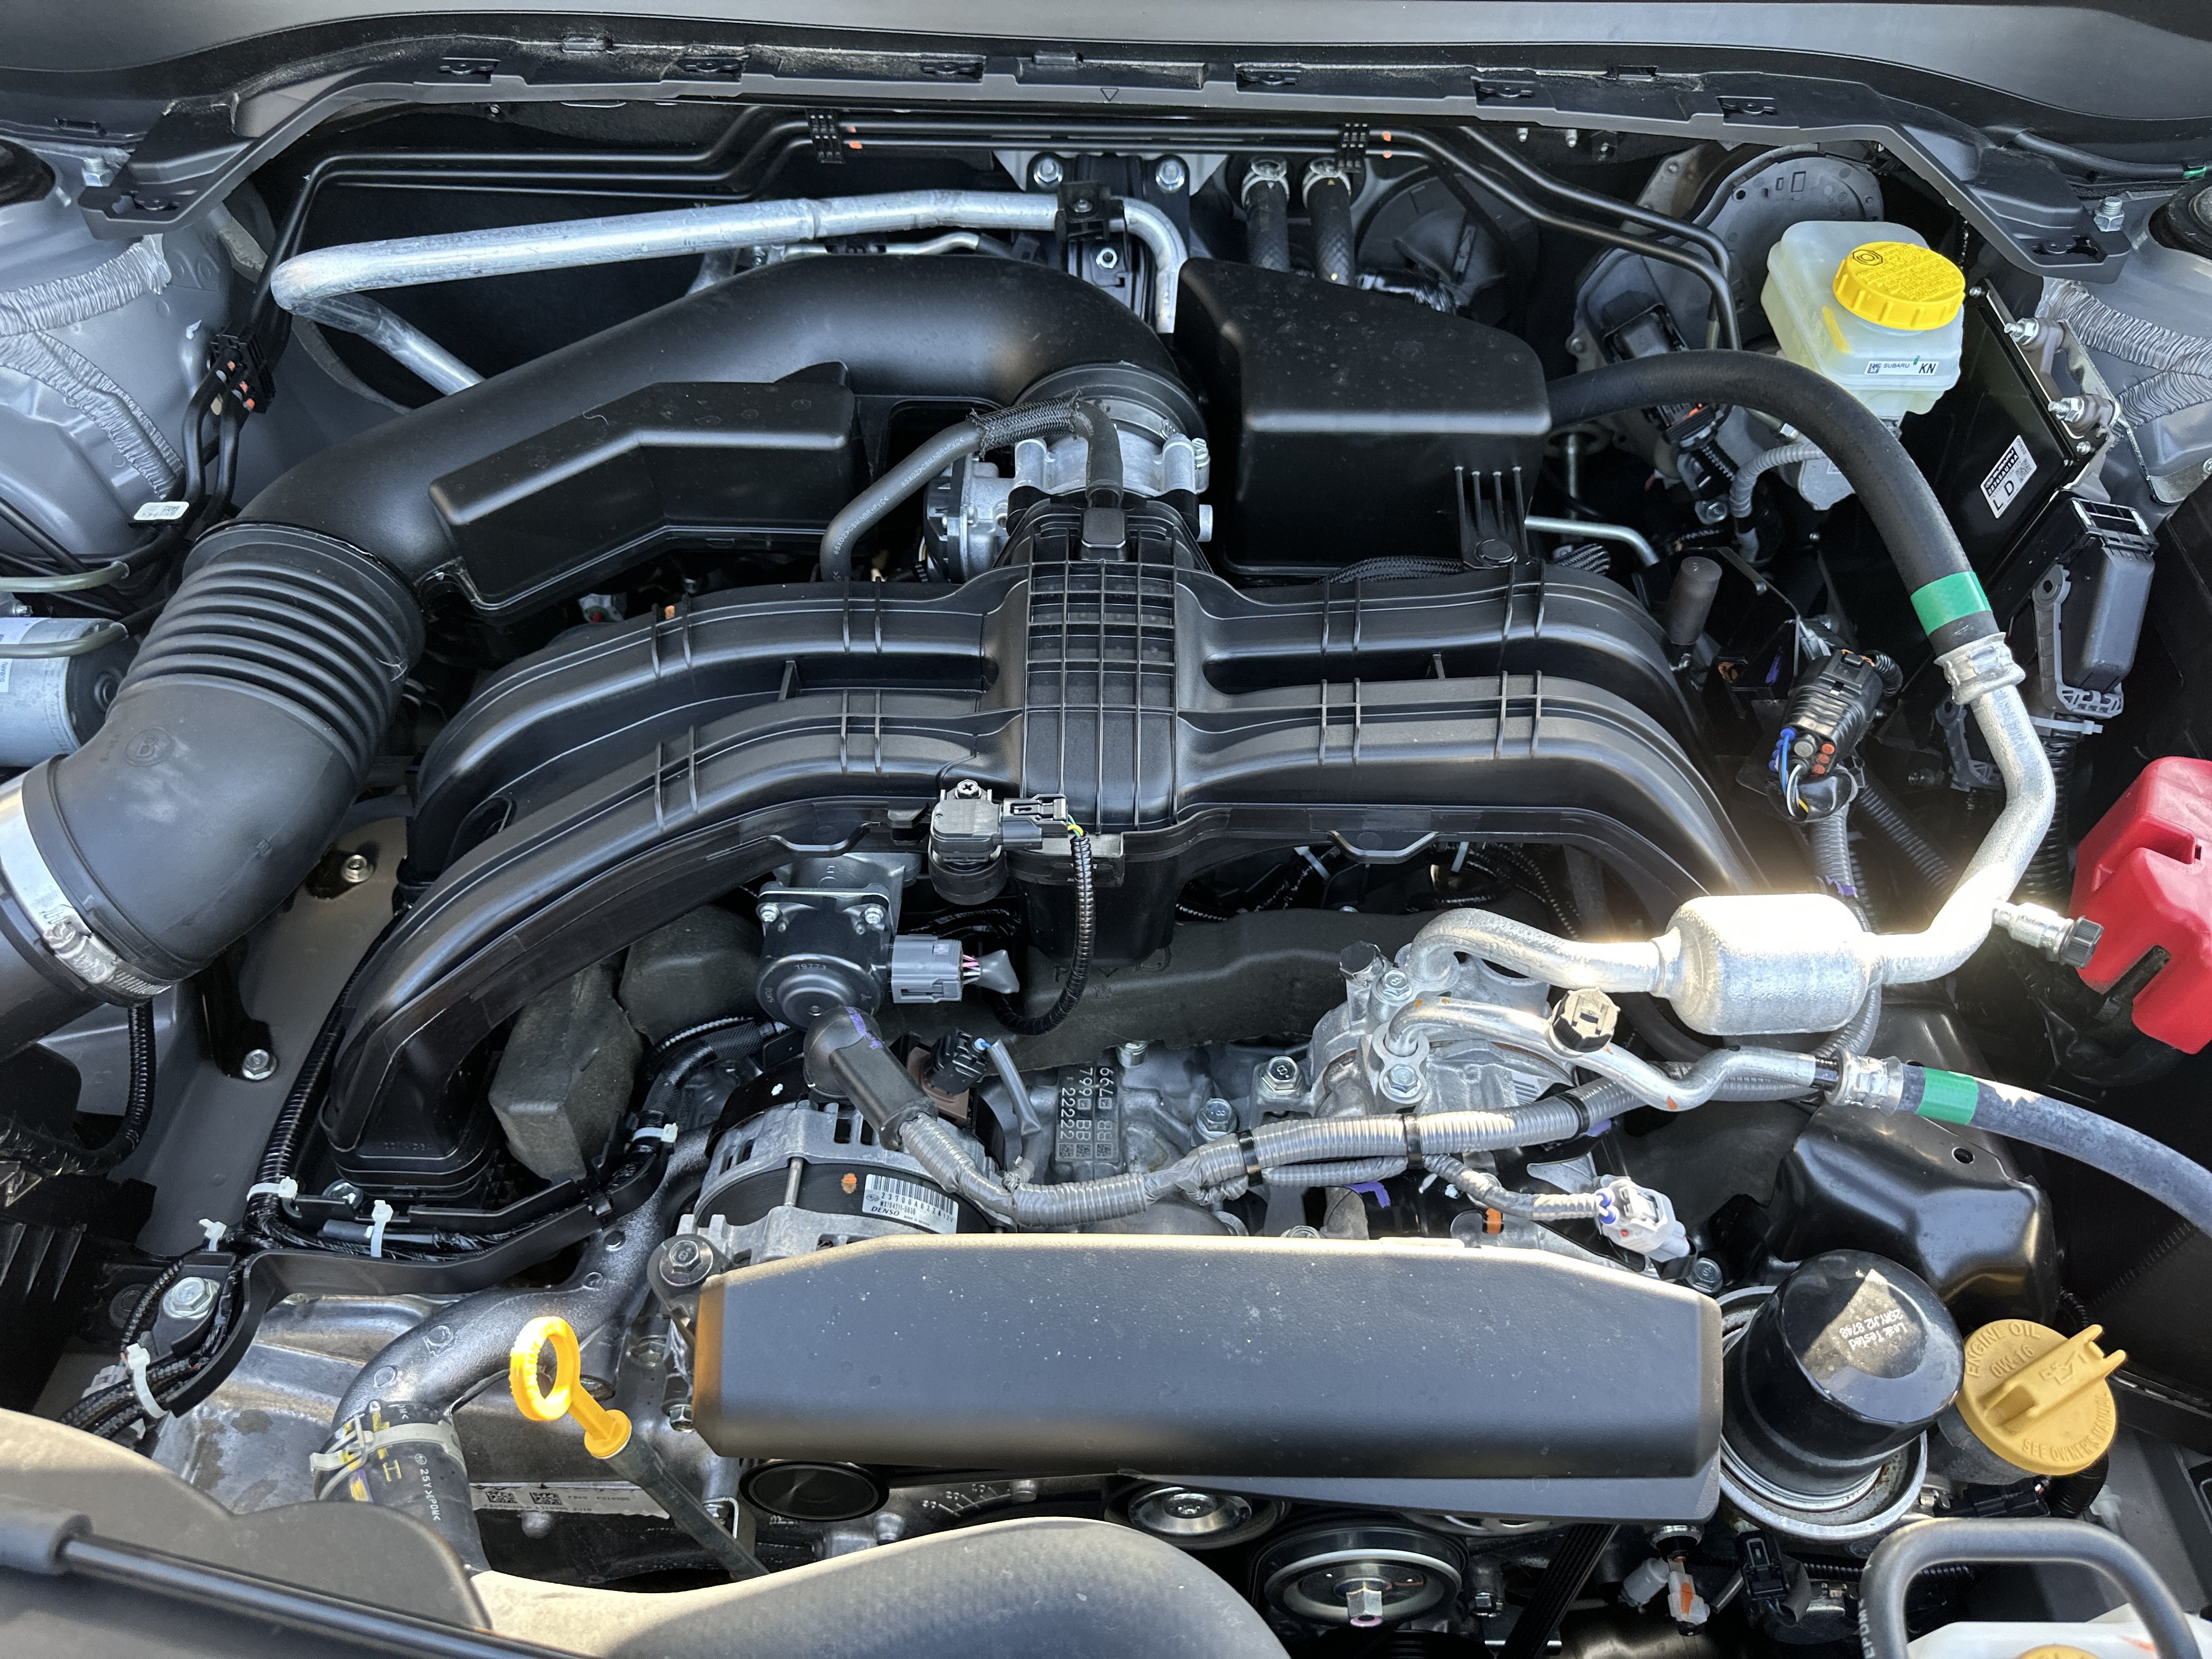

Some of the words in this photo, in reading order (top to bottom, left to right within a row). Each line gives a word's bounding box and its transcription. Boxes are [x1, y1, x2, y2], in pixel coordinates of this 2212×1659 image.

[1918, 363, 1937, 374] KN
[1992, 494, 2004, 511] L
[2003, 478, 2016, 496] D
[1079, 1067, 1093, 1096] 799
[1060, 1087, 1076, 1139] 22222
[1076, 1120, 1091, 1141] BB
[871, 1206, 900, 1216] DENSO
[1848, 1330, 1884, 1351] Tested
[1966, 1323, 2007, 1378] ENGINE
[2008, 1321, 2041, 1339] OIL
[2022, 1438, 2047, 1459] SEE
[2050, 1435, 2101, 1462] OWNER'S
[2091, 1392, 2112, 1441] MANUAL
